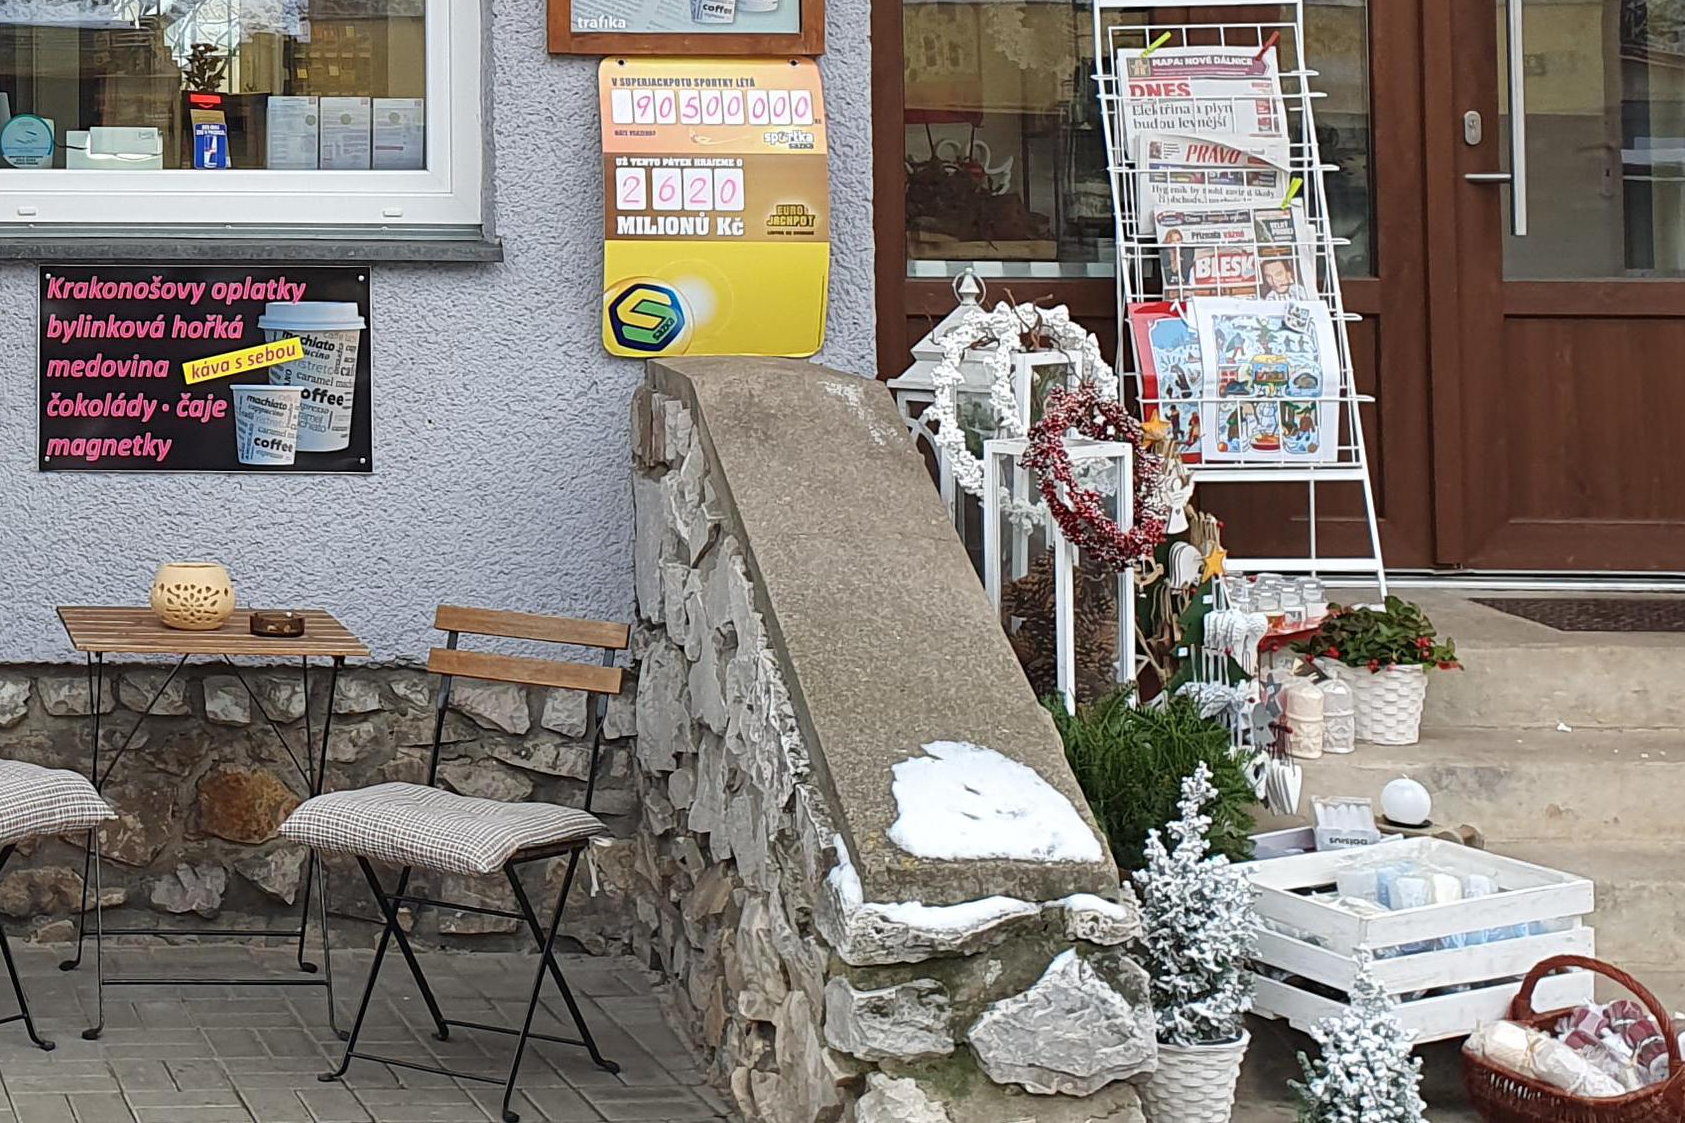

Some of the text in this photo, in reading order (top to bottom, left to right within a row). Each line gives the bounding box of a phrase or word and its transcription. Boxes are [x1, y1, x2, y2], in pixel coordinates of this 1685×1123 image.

[577, 16, 627, 30] trafika
[619, 77, 692, 88] SUPERJACKPOTU
[617, 212, 745, 236] MILIONŮ Kč
[47, 276, 307, 305] Krakonošovy oplatky
[47, 313, 245, 340] bylinková hořká
[47, 352, 170, 378] medovina
[191, 342, 297, 381] káva s sebou
[47, 392, 228, 423] čokolády čaje
[300, 387, 344, 407] offee
[47, 432, 173, 461] magnetky
